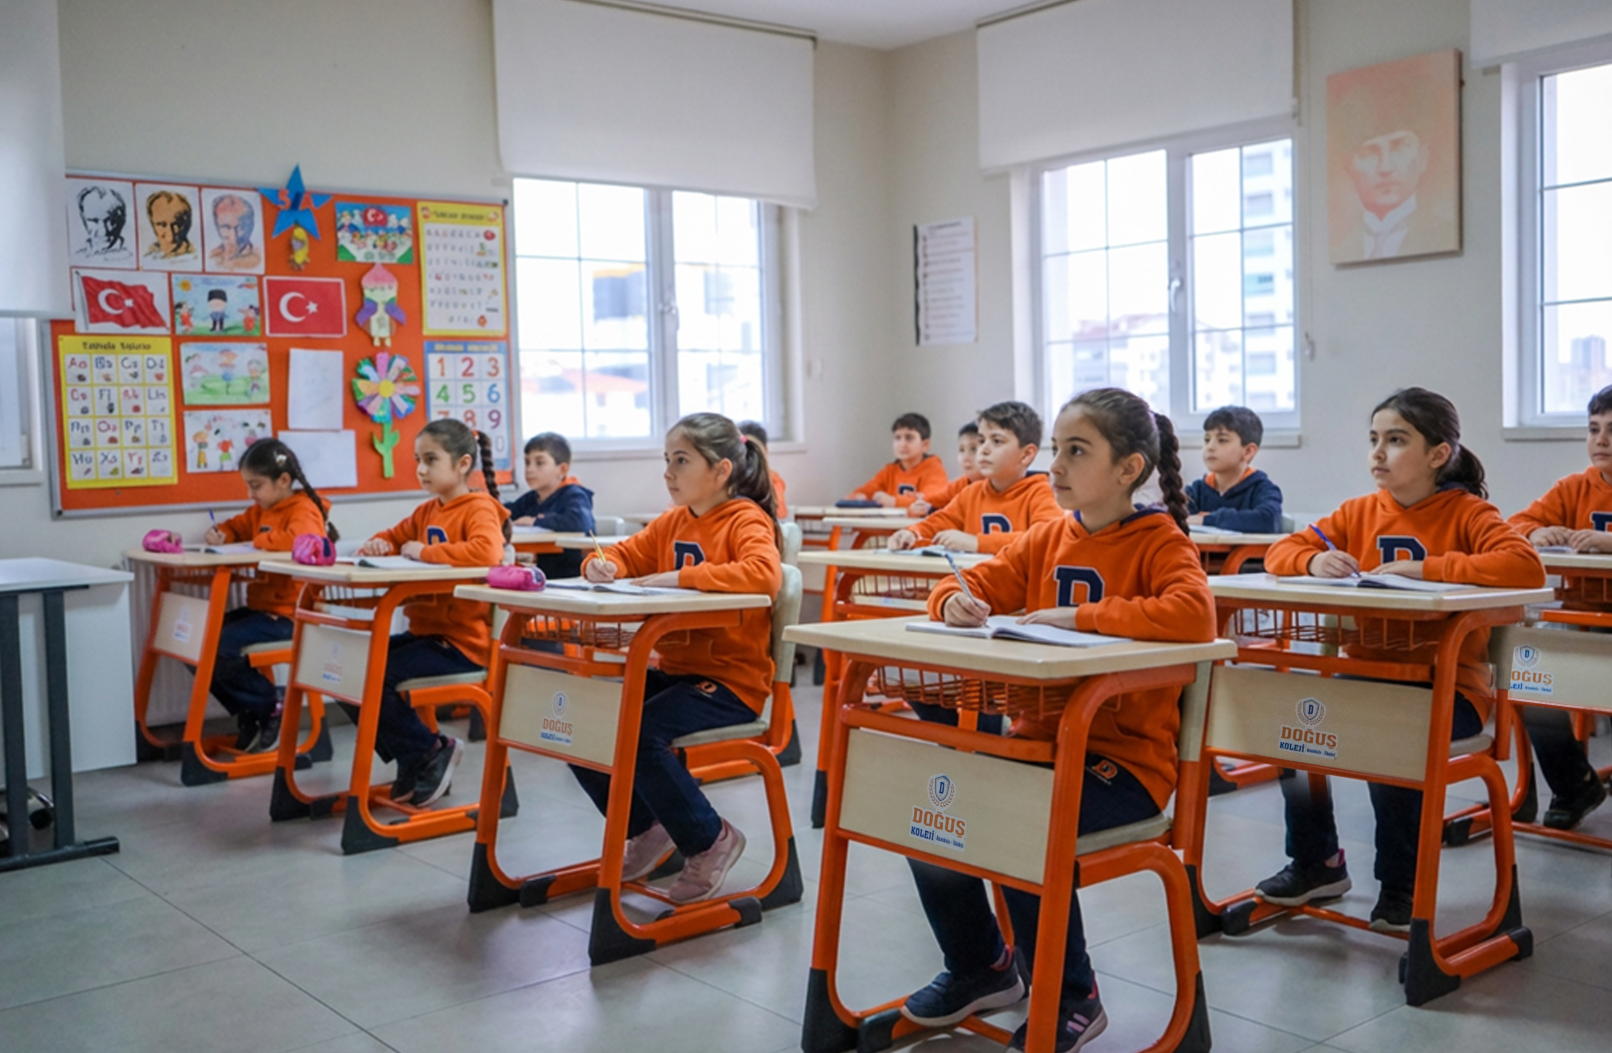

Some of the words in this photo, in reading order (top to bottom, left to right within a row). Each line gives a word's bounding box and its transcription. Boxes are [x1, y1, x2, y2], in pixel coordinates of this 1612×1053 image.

[437, 356, 445, 378] 1
[461, 356, 475, 378] 2
[487, 357, 500, 378] 3
[435, 384, 450, 403] 4
[462, 383, 476, 404] 5
[487, 383, 501, 404] 6
[488, 409, 501, 430] 9
[1053, 565, 1105, 608] D
[1308, 704, 1314, 714] D
[1281, 726, 1337, 749] DOĞUŞ
[939, 781, 945, 794] D
[912, 807, 966, 838] DOĞUŞ
[910, 826, 935, 841] KOLEJİ
